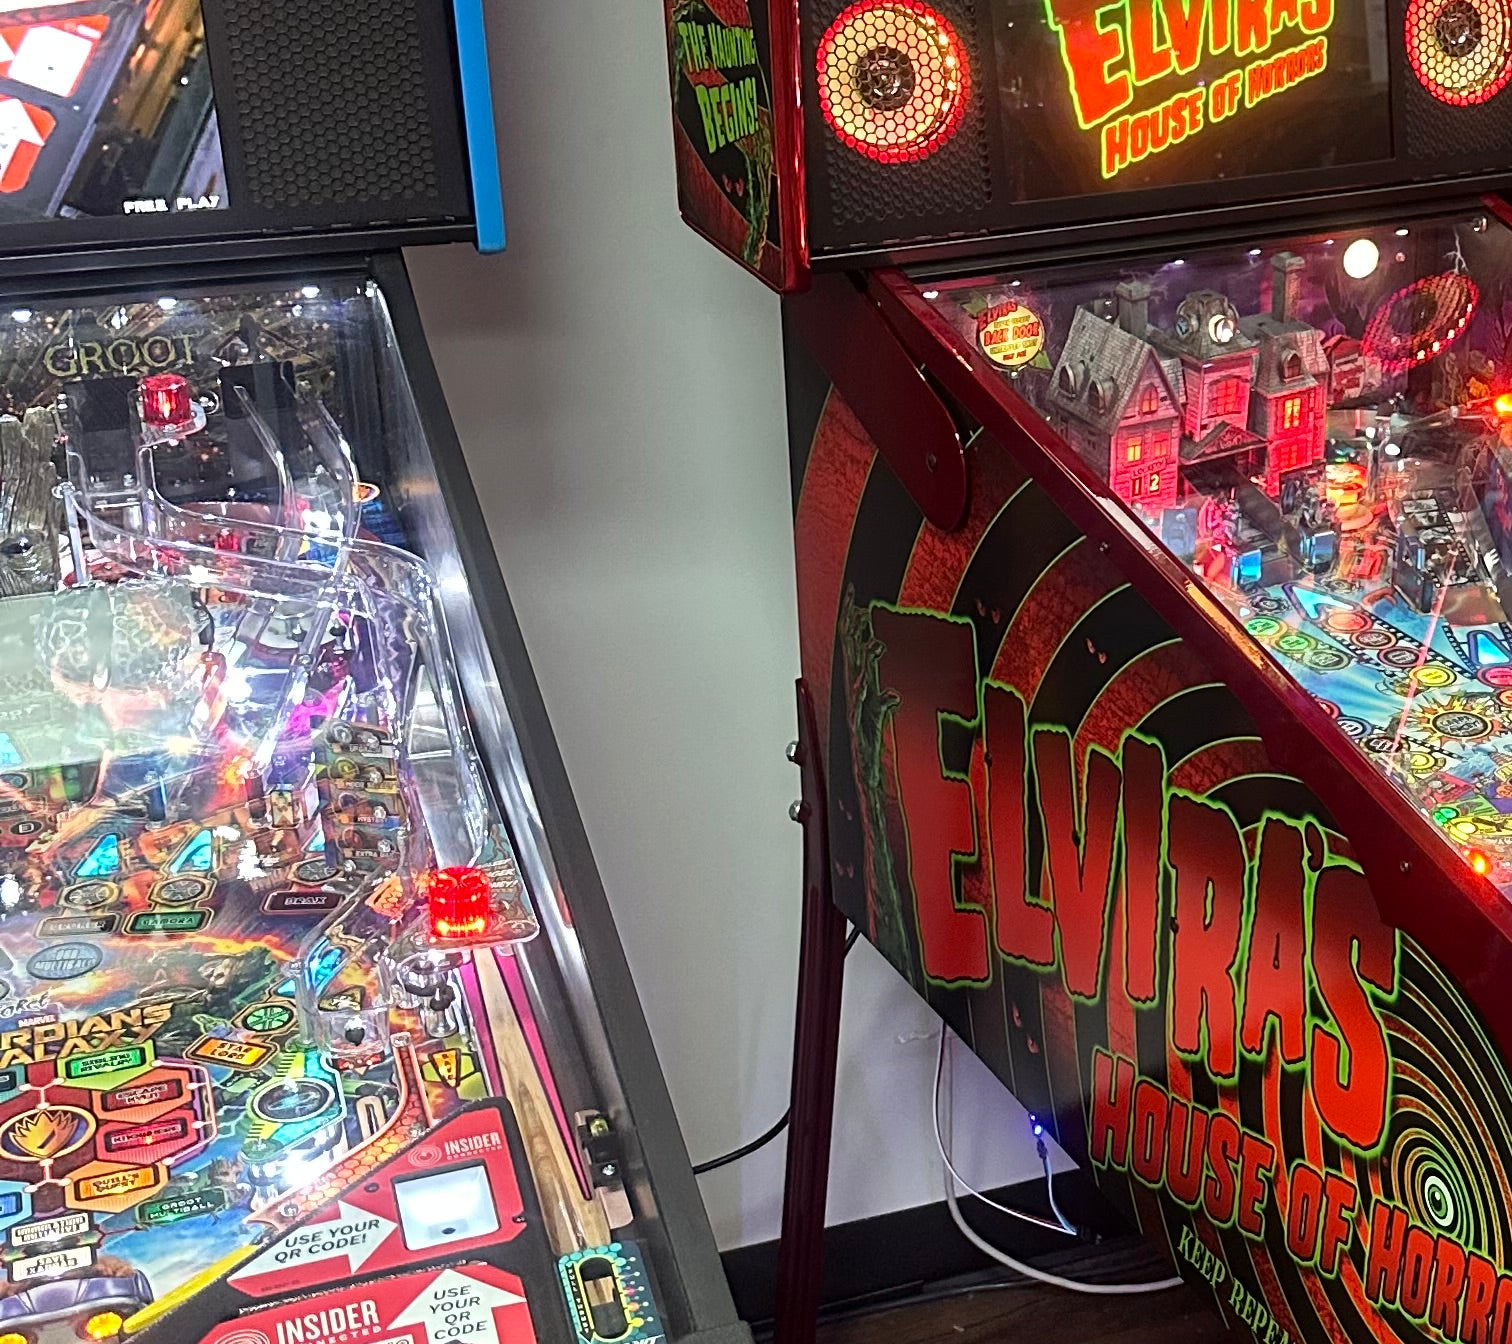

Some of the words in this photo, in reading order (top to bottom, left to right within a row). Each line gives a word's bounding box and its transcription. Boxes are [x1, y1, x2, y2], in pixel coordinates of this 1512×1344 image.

[677, 21, 707, 72] THE
[709, 23, 756, 69] HAUNTING
[695, 77, 760, 154] BEGINS!
[1101, 101, 1205, 179] HOUSE
[1212, 74, 1241, 123] OF
[1247, 38, 1328, 108] HORRORS
[124, 199, 168, 214] FREE
[177, 195, 220, 211] PLAY
[984, 328, 1008, 346] BACK
[1012, 321, 1040, 340] DOOR
[43, 331, 202, 378] GROOT
[1150, 473, 1159, 491] 2
[870, 602, 1404, 1152] ELVIRA'S
[285, 895, 327, 907] DRAX
[141, 916, 195, 930] GAMORA
[18, 1014, 57, 1028] MARVEL
[210, 1049, 246, 1061] LORD
[216, 1042, 254, 1054] STAR
[445, 1132, 501, 1154] INSIDER
[1090, 1051, 1274, 1239] HOUSE
[1286, 1160, 1358, 1276] OF
[150, 1202, 215, 1219] MULTIBALL
[162, 1197, 202, 1211] GROOT
[285, 1232, 323, 1248] USE
[329, 1218, 380, 1239] YOUR
[274, 1248, 301, 1264] QR
[308, 1234, 367, 1256] CODE!
[1179, 1225, 1225, 1289] KEEP
[434, 1284, 471, 1300] USE
[429, 1296, 481, 1315] YOUR
[443, 1309, 471, 1324] QR
[434, 1320, 487, 1341] CODE
